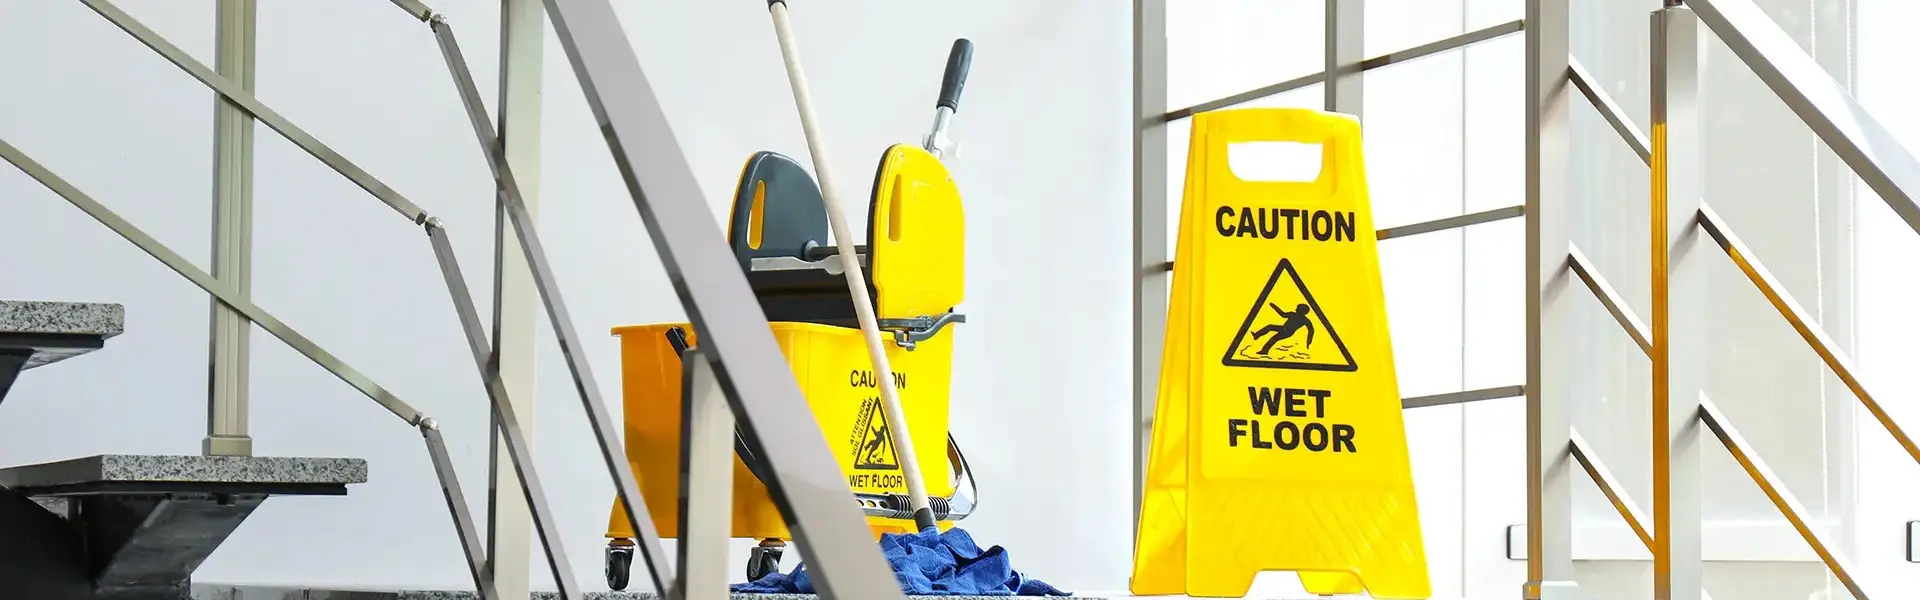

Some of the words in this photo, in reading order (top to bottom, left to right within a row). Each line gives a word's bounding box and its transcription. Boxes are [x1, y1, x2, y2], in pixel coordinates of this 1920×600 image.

[1215, 205, 1356, 242] CAUTION
[850, 370, 906, 389] CAUN
[1248, 386, 1331, 418] WET
[850, 399, 867, 444] ATTENTION
[852, 441, 860, 456] SOL
[857, 398, 873, 439] GLISSANT
[1228, 419, 1357, 452] FLOOR
[849, 475, 869, 488] WET
[872, 474, 903, 488] FLOOR
